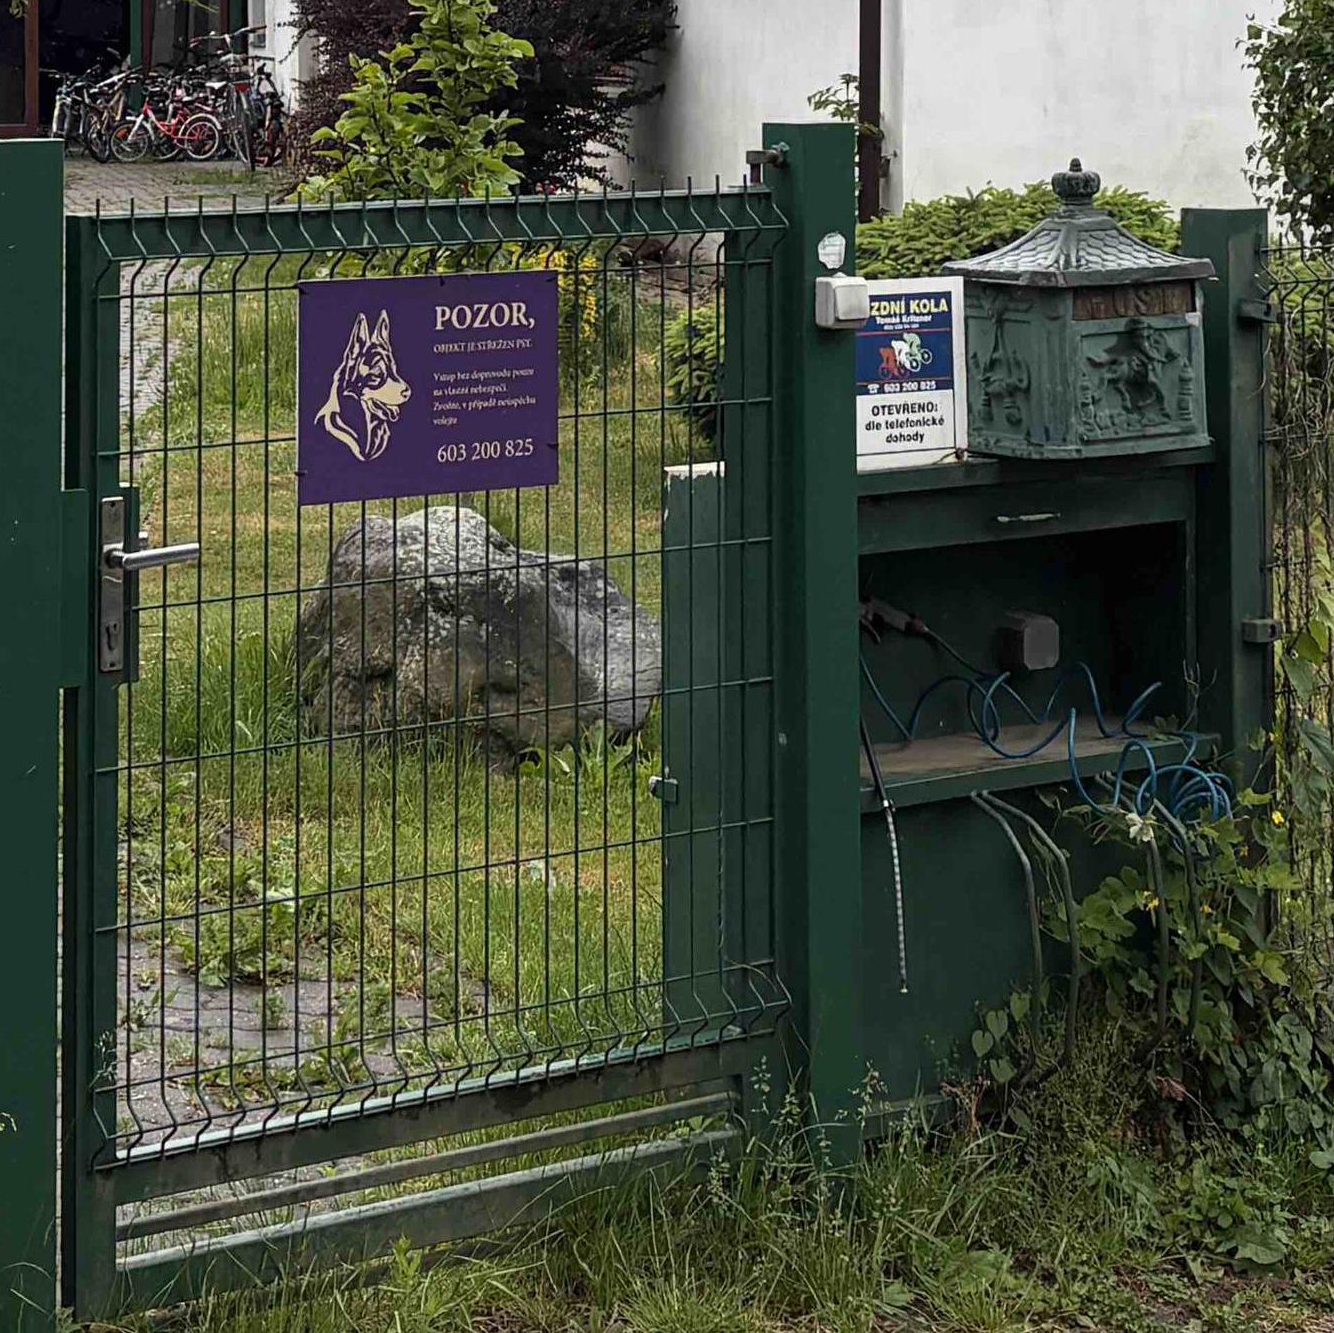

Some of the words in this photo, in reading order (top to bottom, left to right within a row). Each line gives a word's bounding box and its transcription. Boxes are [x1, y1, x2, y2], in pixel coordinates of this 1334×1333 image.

[870, 296, 906, 316] ZDNÍ
[909, 298, 949, 314] KOLA
[434, 302, 536, 331] POZOR,
[871, 401, 938, 417] OTEVŘENO:
[865, 420, 882, 431] dle
[885, 415, 945, 430] telefonické
[885, 430, 925, 443] dohody
[437, 444, 467, 463] 603
[471, 441, 501, 461] 200
[505, 438, 534, 457] 825
